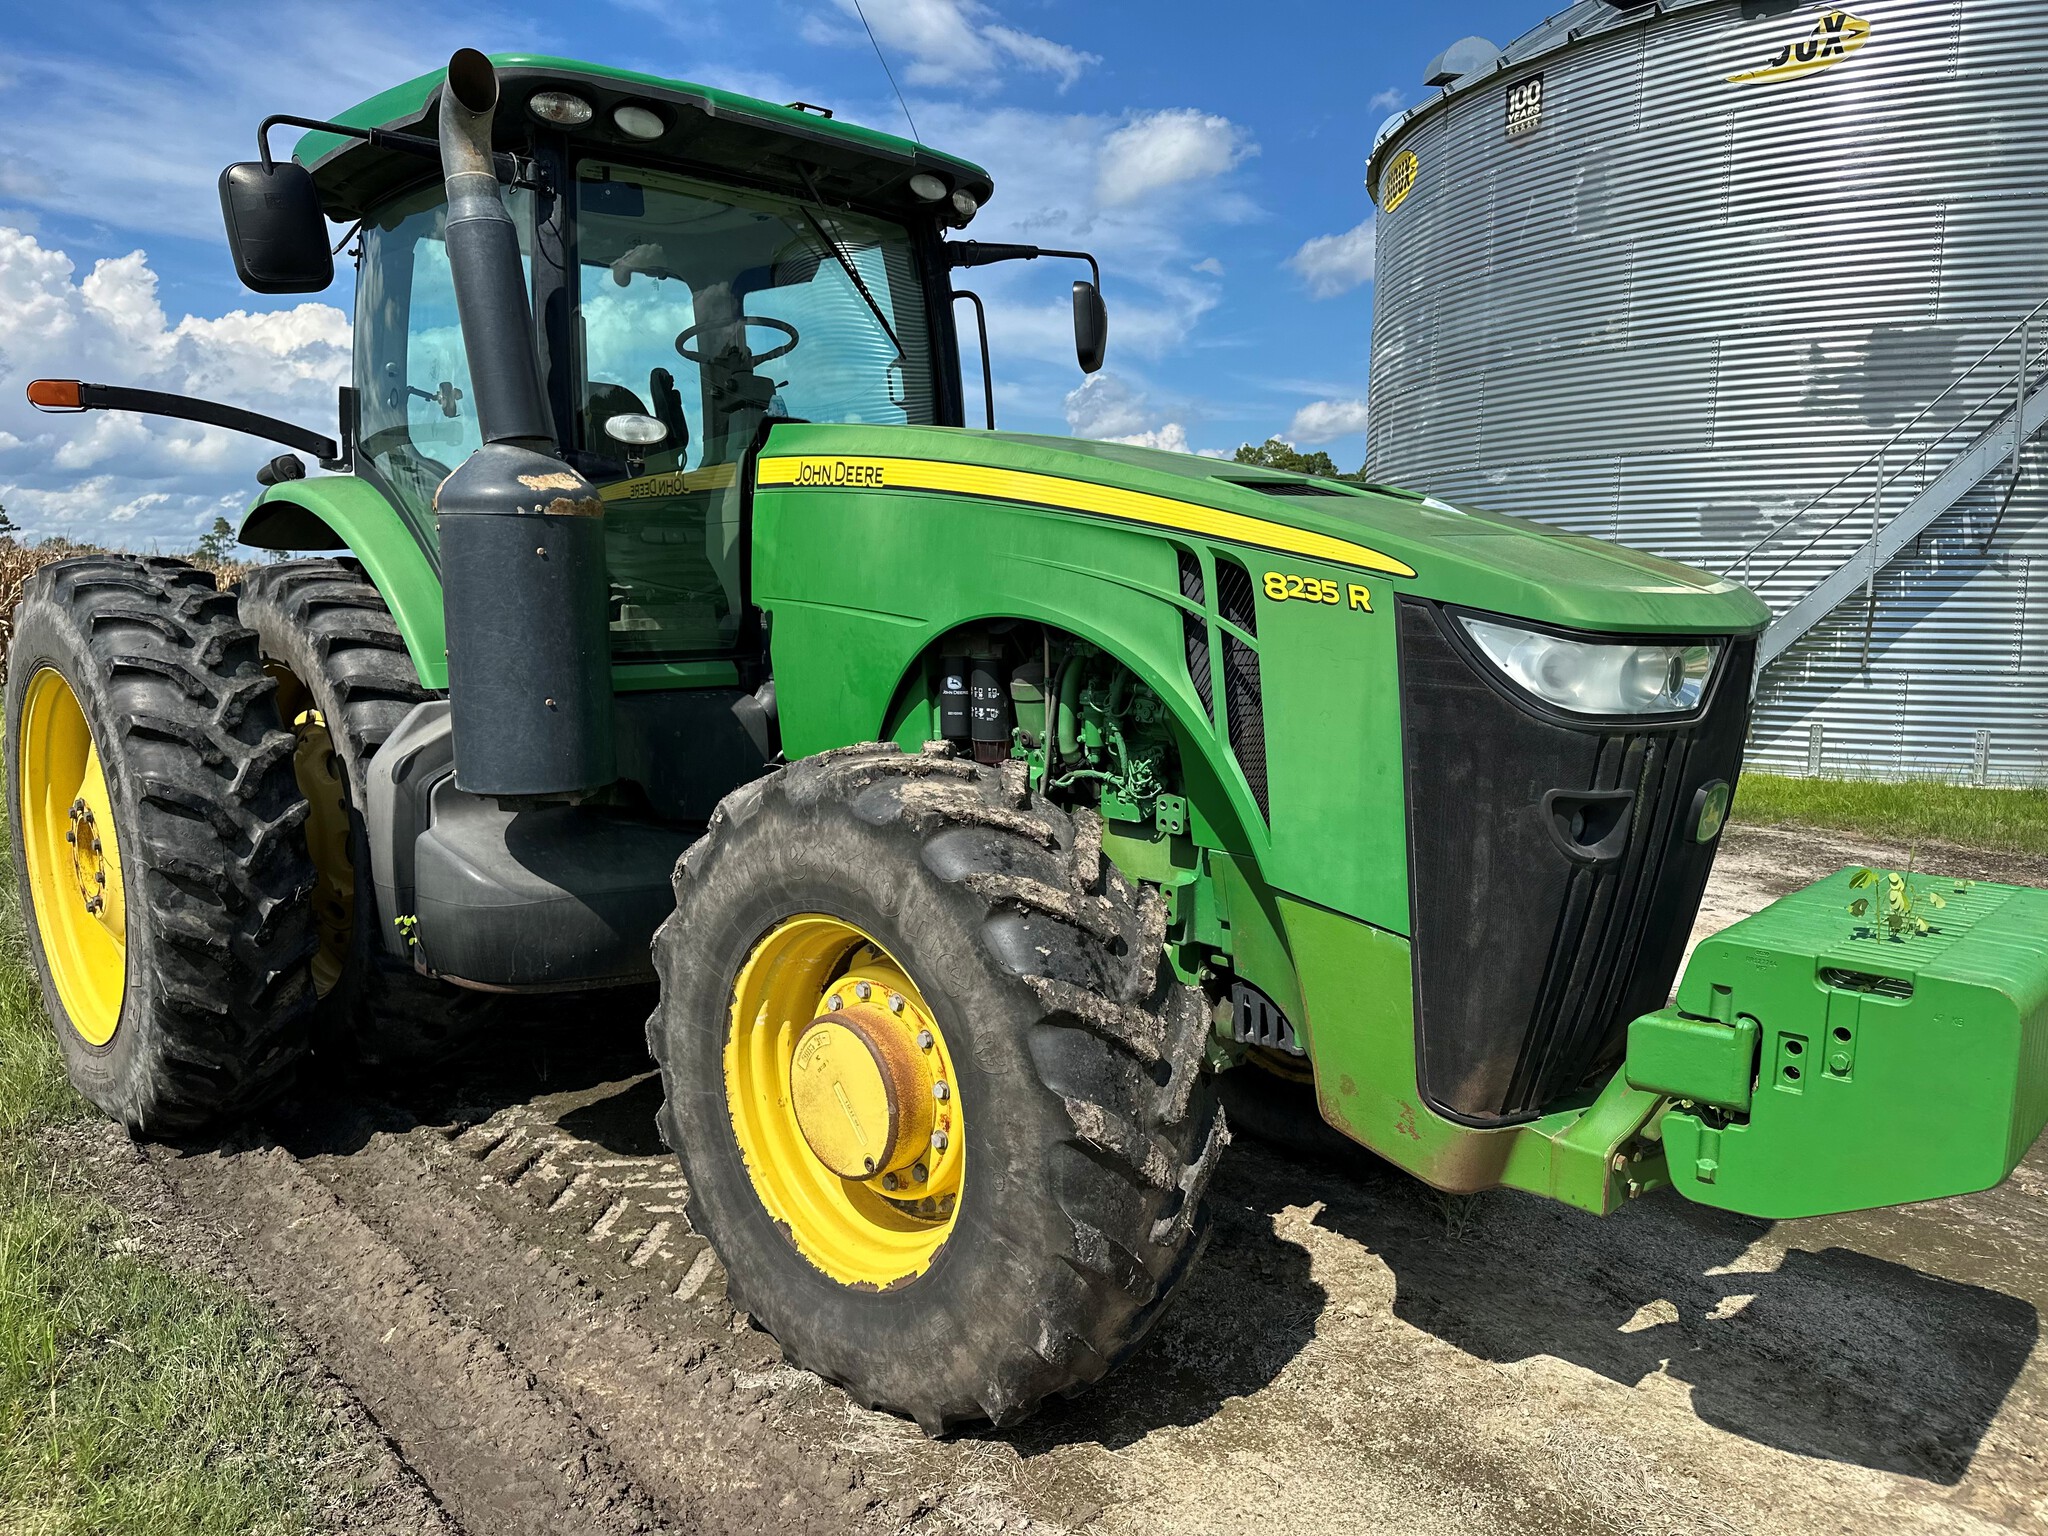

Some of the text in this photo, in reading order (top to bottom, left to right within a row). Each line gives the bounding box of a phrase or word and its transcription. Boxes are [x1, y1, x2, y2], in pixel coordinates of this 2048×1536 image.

[1508, 80, 1541, 113] 100
[1508, 104, 1541, 123] YEARS
[794, 461, 884, 485] JOHN DEERE
[1262, 571, 1374, 613] 8235 R
[716, 834, 975, 998] irestone
